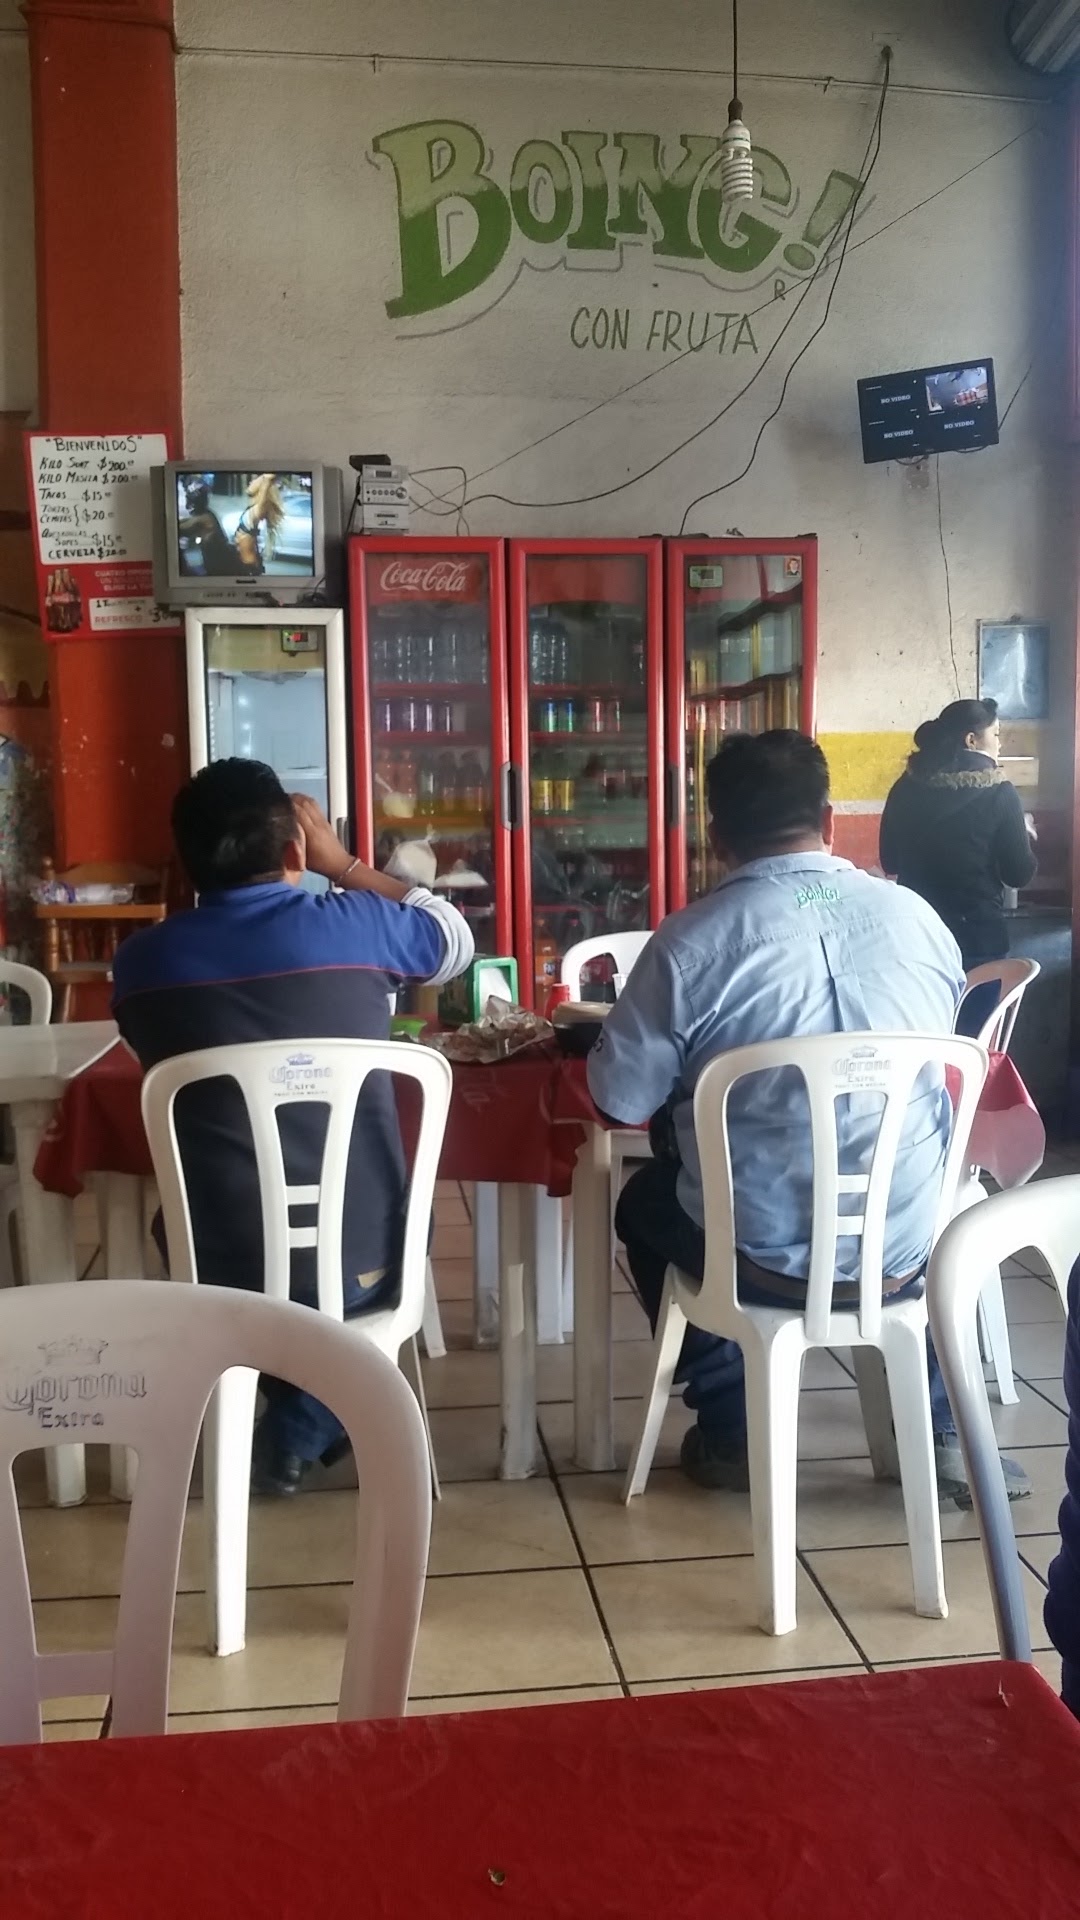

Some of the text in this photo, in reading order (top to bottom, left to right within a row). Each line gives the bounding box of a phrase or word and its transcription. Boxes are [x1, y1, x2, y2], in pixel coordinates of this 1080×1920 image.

[371, 118, 863, 319] BOING!
[570, 306, 759, 354] CON FRUTA
[40, 457, 63, 470] KILO
[38, 472, 62, 484] KILO
[39, 488, 67, 500] TACOS
[48, 548, 96, 559] CERVEZA
[380, 561, 470, 592] Coca-Cola
[94, 615, 143, 623] REFRESCO
[269, 1065, 334, 1084] Corona
[0, 1370, 147, 1415] Corona
[38, 1407, 105, 1428] Extra
